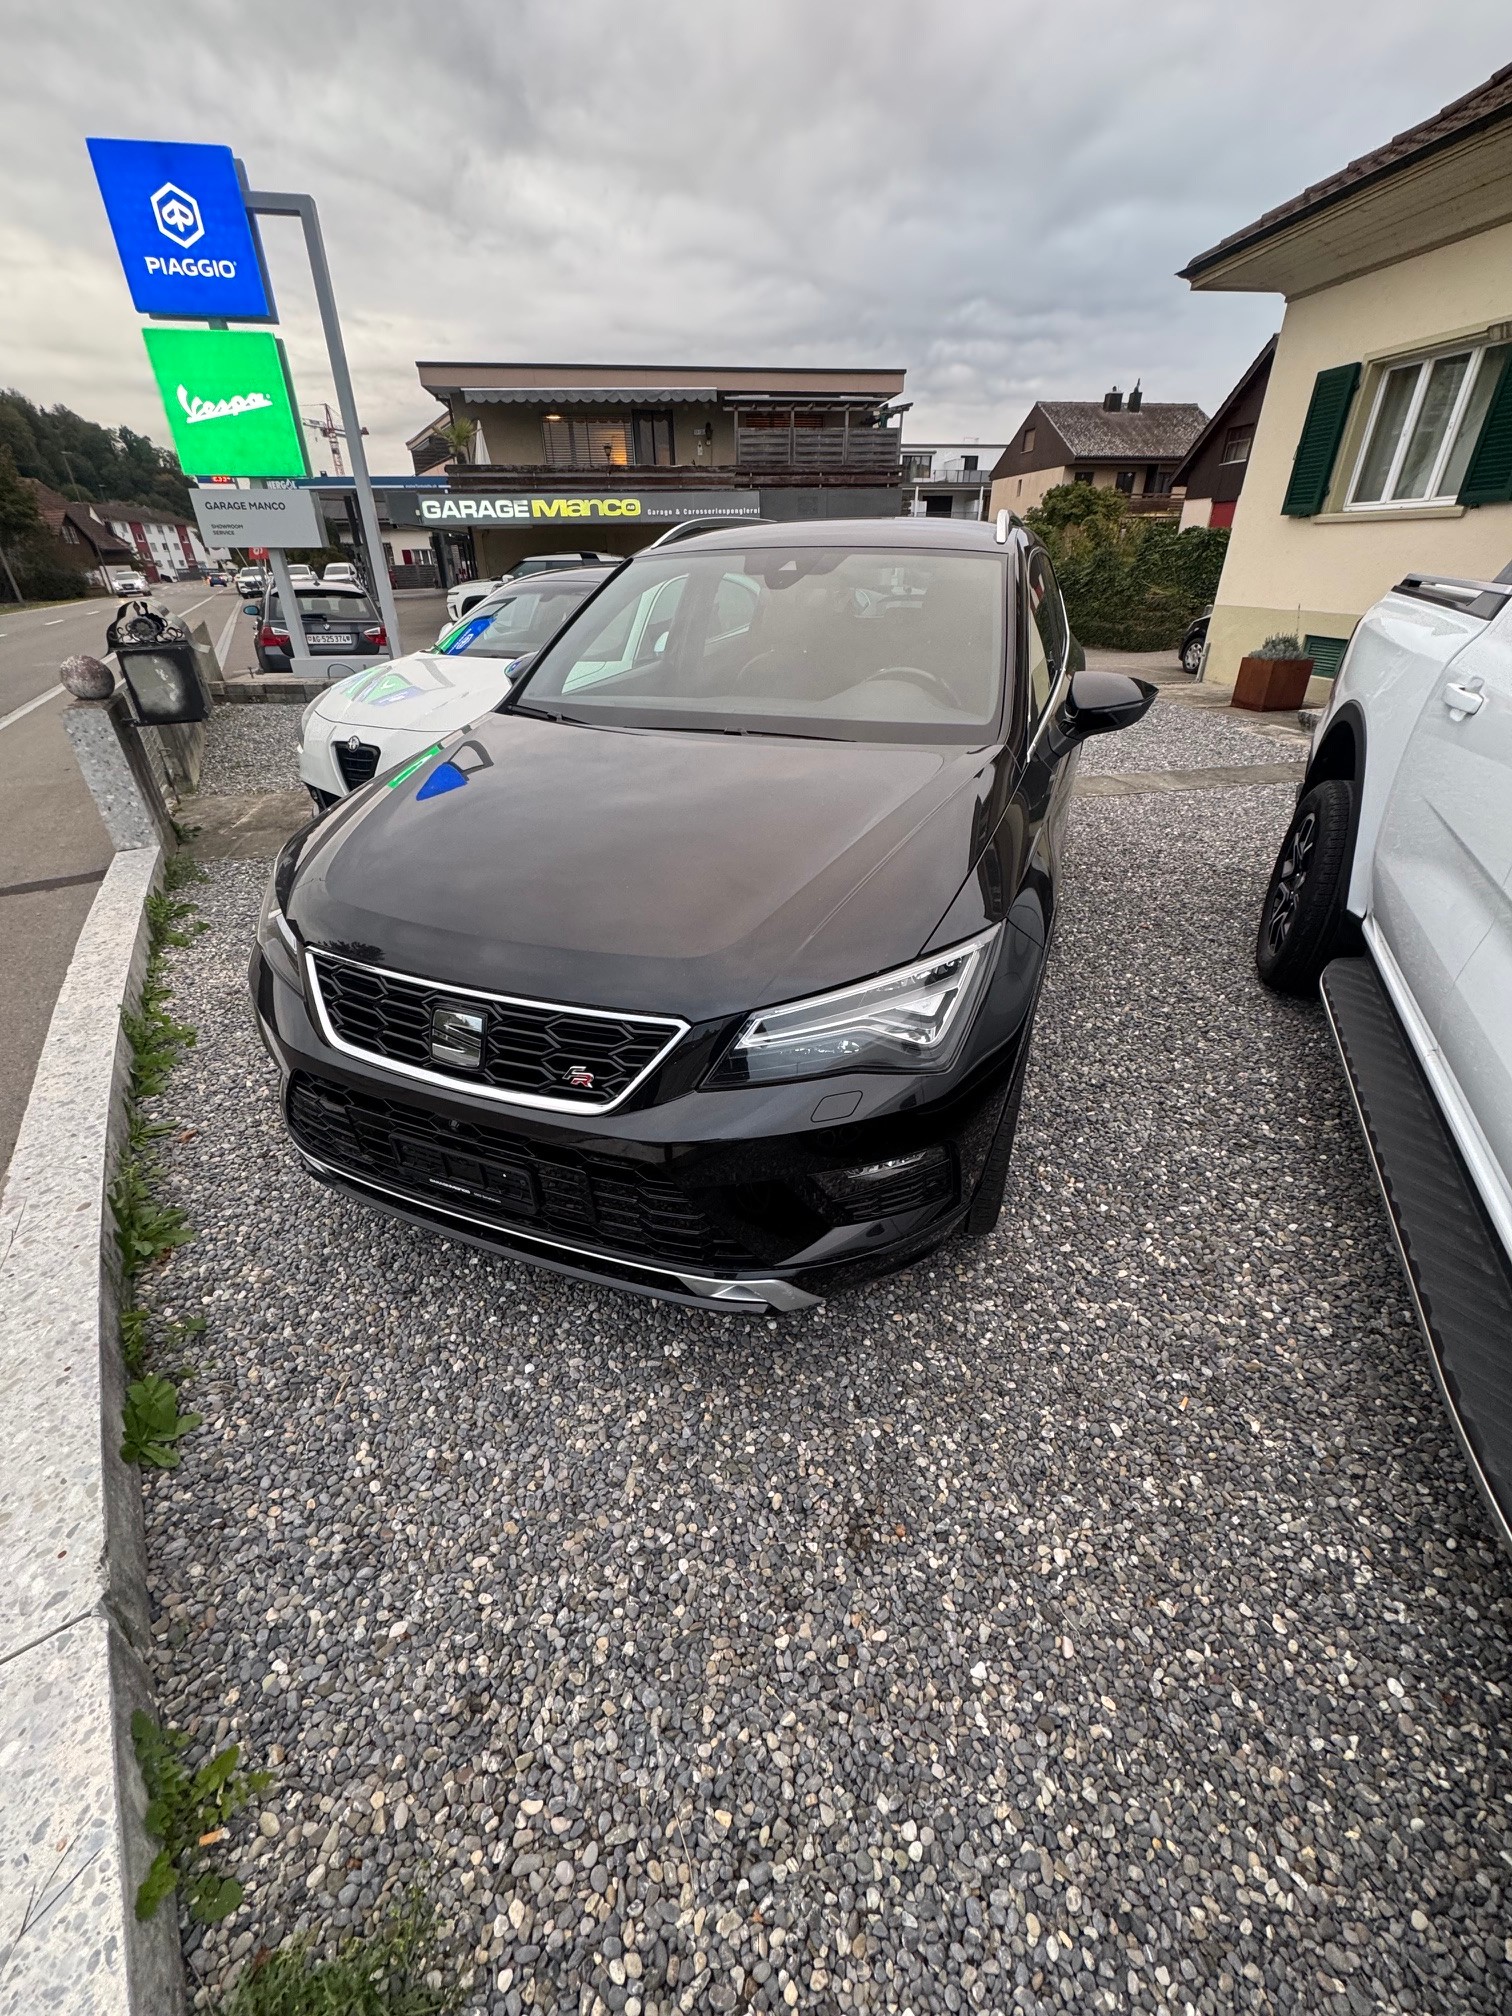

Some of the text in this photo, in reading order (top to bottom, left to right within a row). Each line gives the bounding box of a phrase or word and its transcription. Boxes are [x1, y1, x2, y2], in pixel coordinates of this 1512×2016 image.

[143, 256, 237, 278] PIAGGIO
[176, 383, 273, 424] Vespa
[204, 501, 287, 511] GARAGE MANCO
[421, 500, 531, 519] GARAGE
[647, 508, 673, 517] Garage
[561, 1065, 595, 1089] FR
